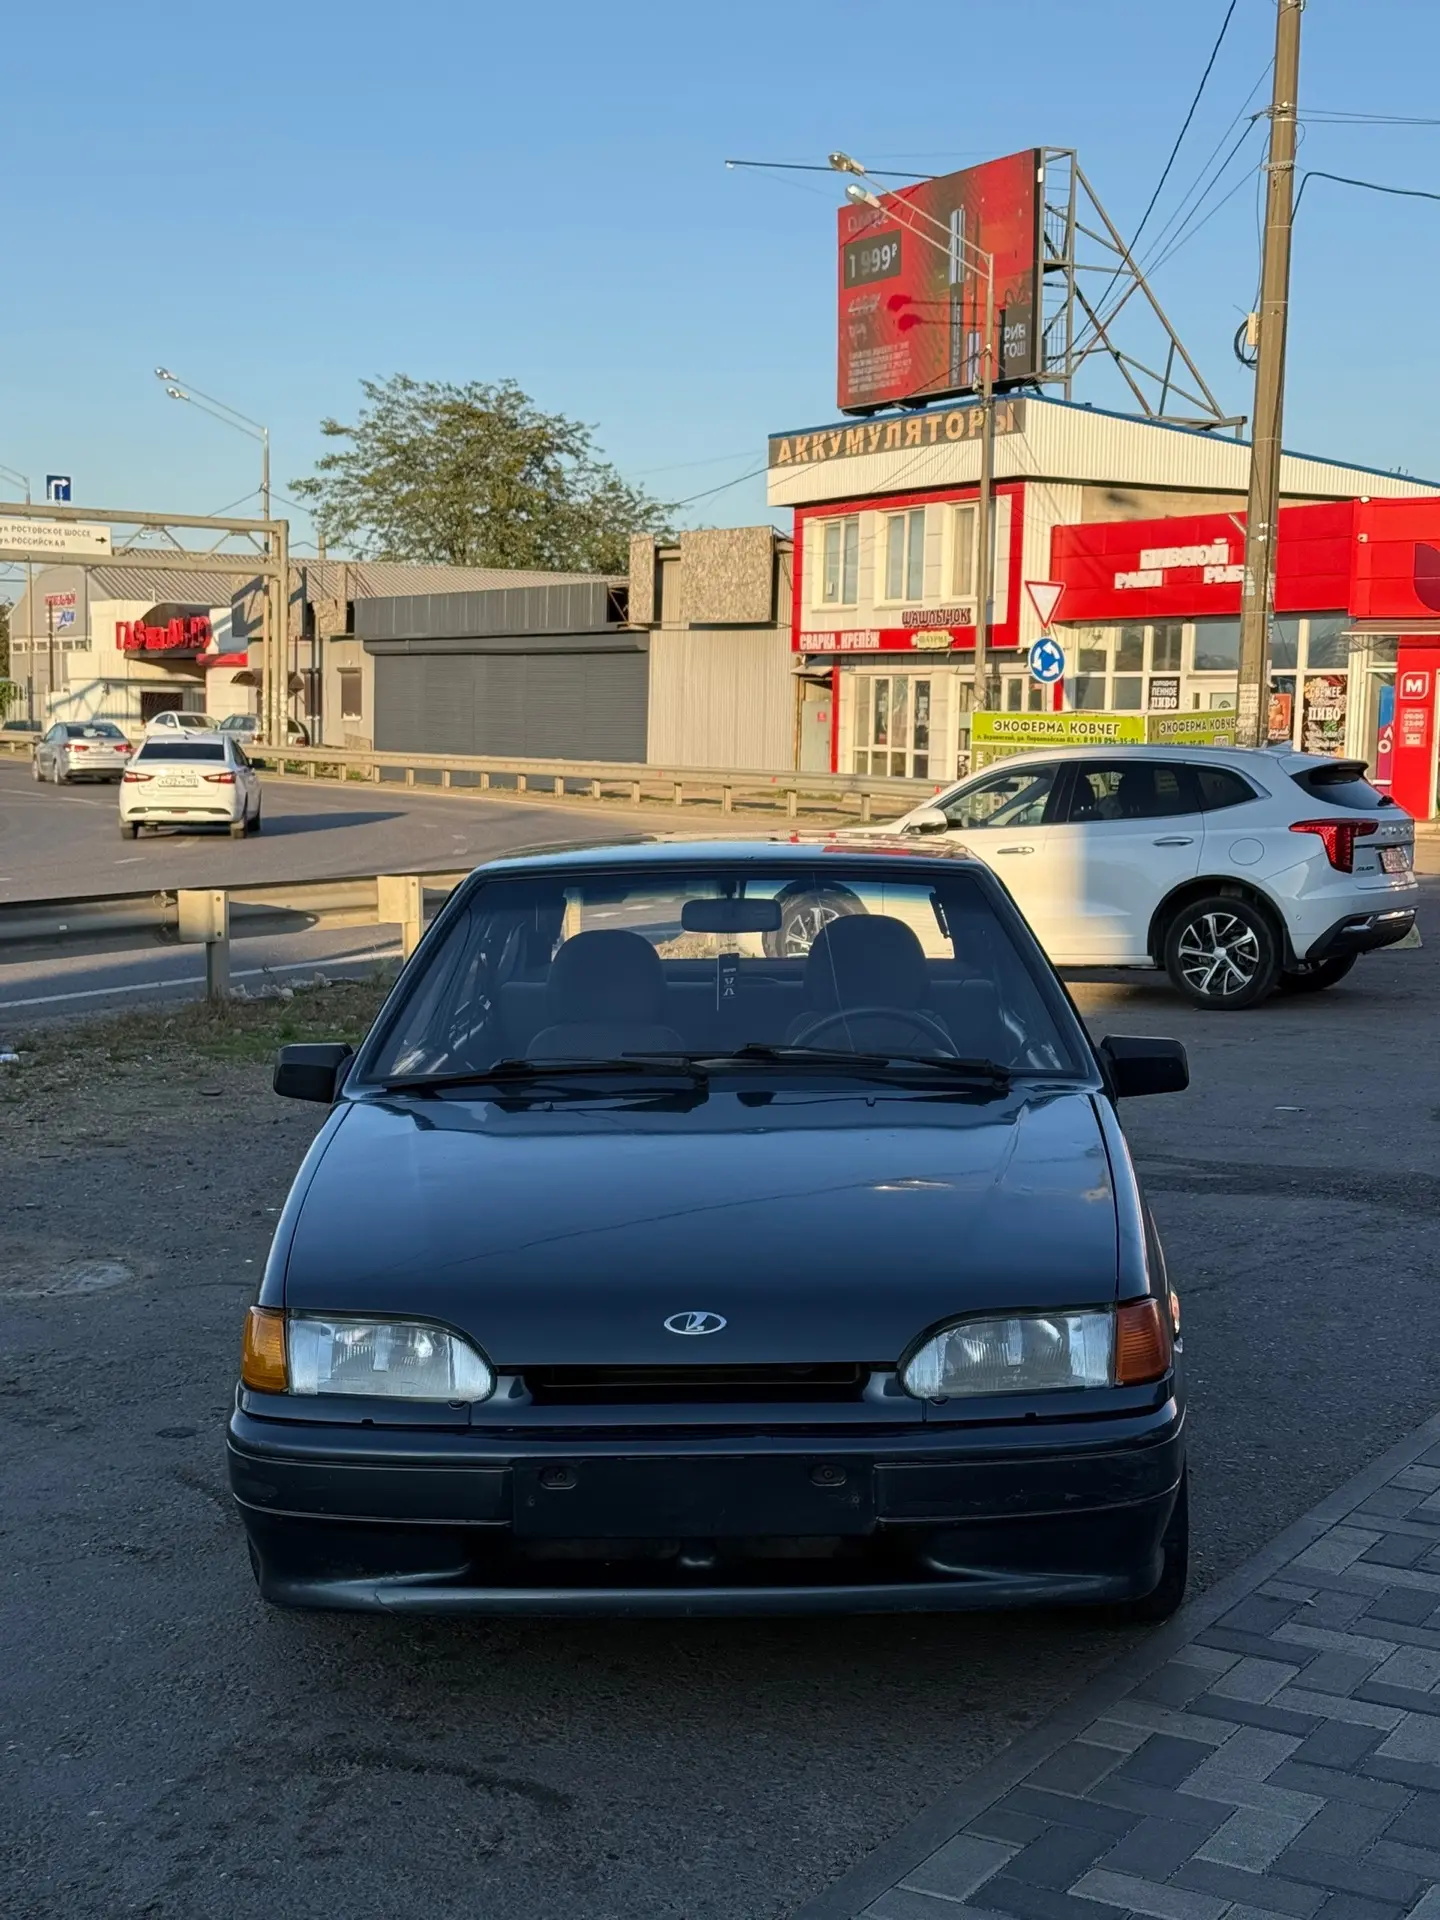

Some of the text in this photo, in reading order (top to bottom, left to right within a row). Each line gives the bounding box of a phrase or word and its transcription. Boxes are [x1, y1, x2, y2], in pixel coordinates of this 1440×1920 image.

[777, 403, 1014, 464] АККУМУЛЯТОРЫ
[11, 525, 62, 537] РОСТОВСКОЕ
[64, 529, 91, 538] ШОССЕ
[12, 536, 66, 547] РОССИЙСКАЯ
[902, 607, 972, 628] ШАШЛЫЧОК
[1151, 697, 1178, 709] ПИВО
[1308, 707, 1341, 721] ПИВО
[993, 720, 1121, 736] ЭКОФЕРМА КОВЧЕГ
[1160, 717, 1236, 734] ЭКОФЕРМА КОВЧЕ
